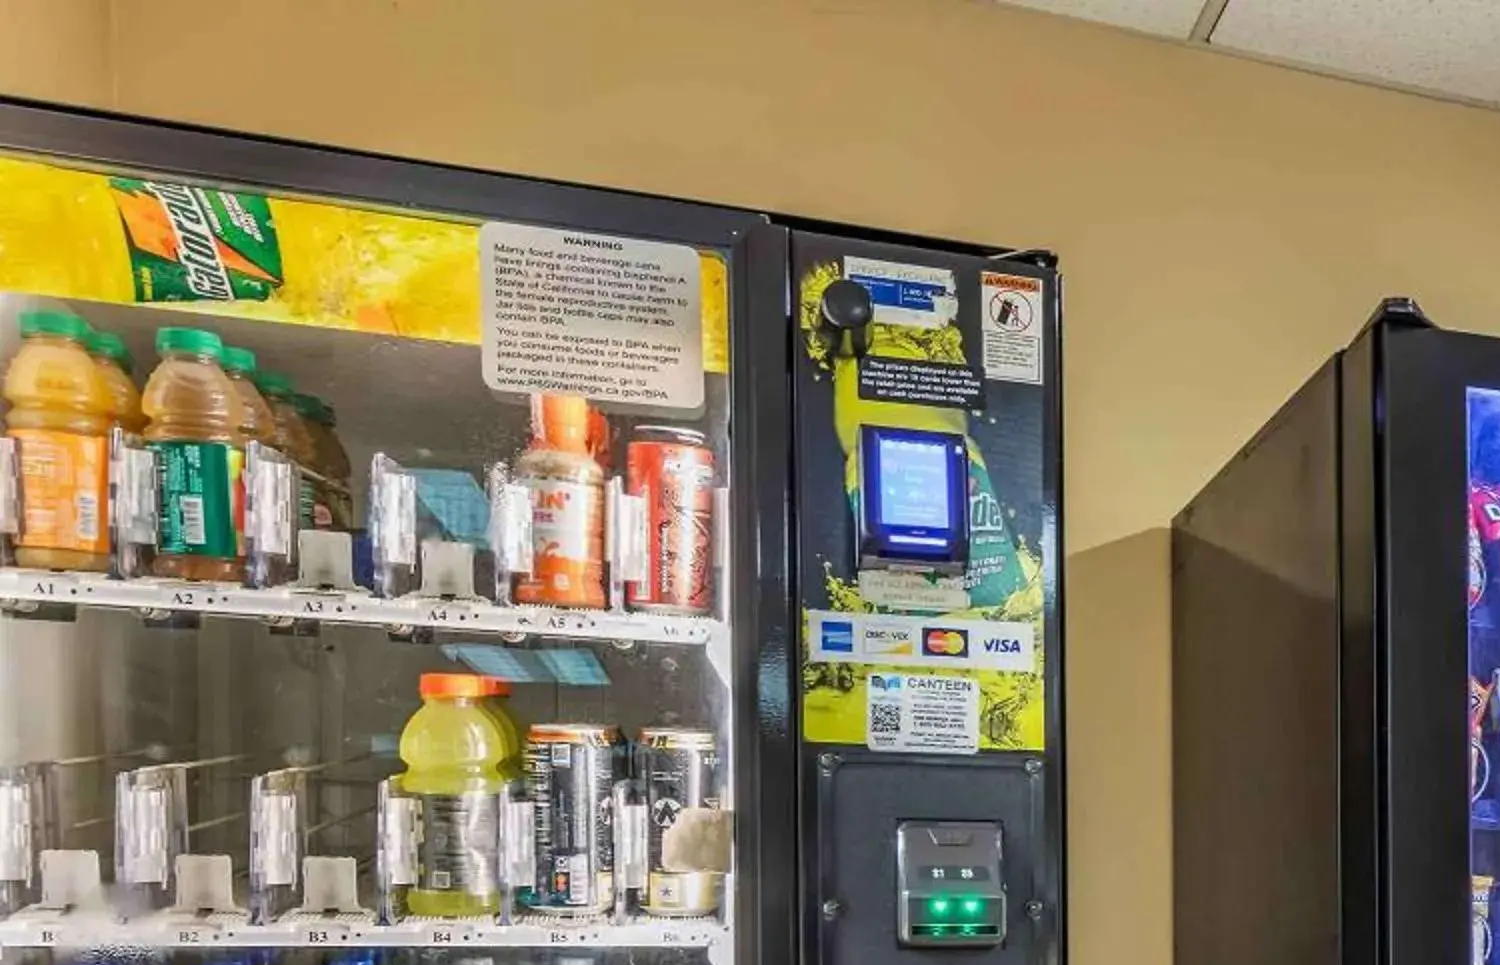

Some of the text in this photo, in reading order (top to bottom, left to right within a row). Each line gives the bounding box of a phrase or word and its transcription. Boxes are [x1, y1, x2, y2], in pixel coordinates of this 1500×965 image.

[144, 181, 236, 301] Gatorad
[563, 236, 624, 251] WARNING
[33, 581, 55, 595] A1
[172, 592, 194, 606] A2
[303, 599, 324, 613] A3
[427, 609, 448, 622] A4
[547, 616, 566, 630] A5
[984, 638, 1022, 654] VISA
[907, 677, 972, 692] CANTEEN
[41, 931, 57, 945] B
[179, 931, 200, 945] B2
[308, 930, 329, 944] B3
[432, 930, 452, 943] B4
